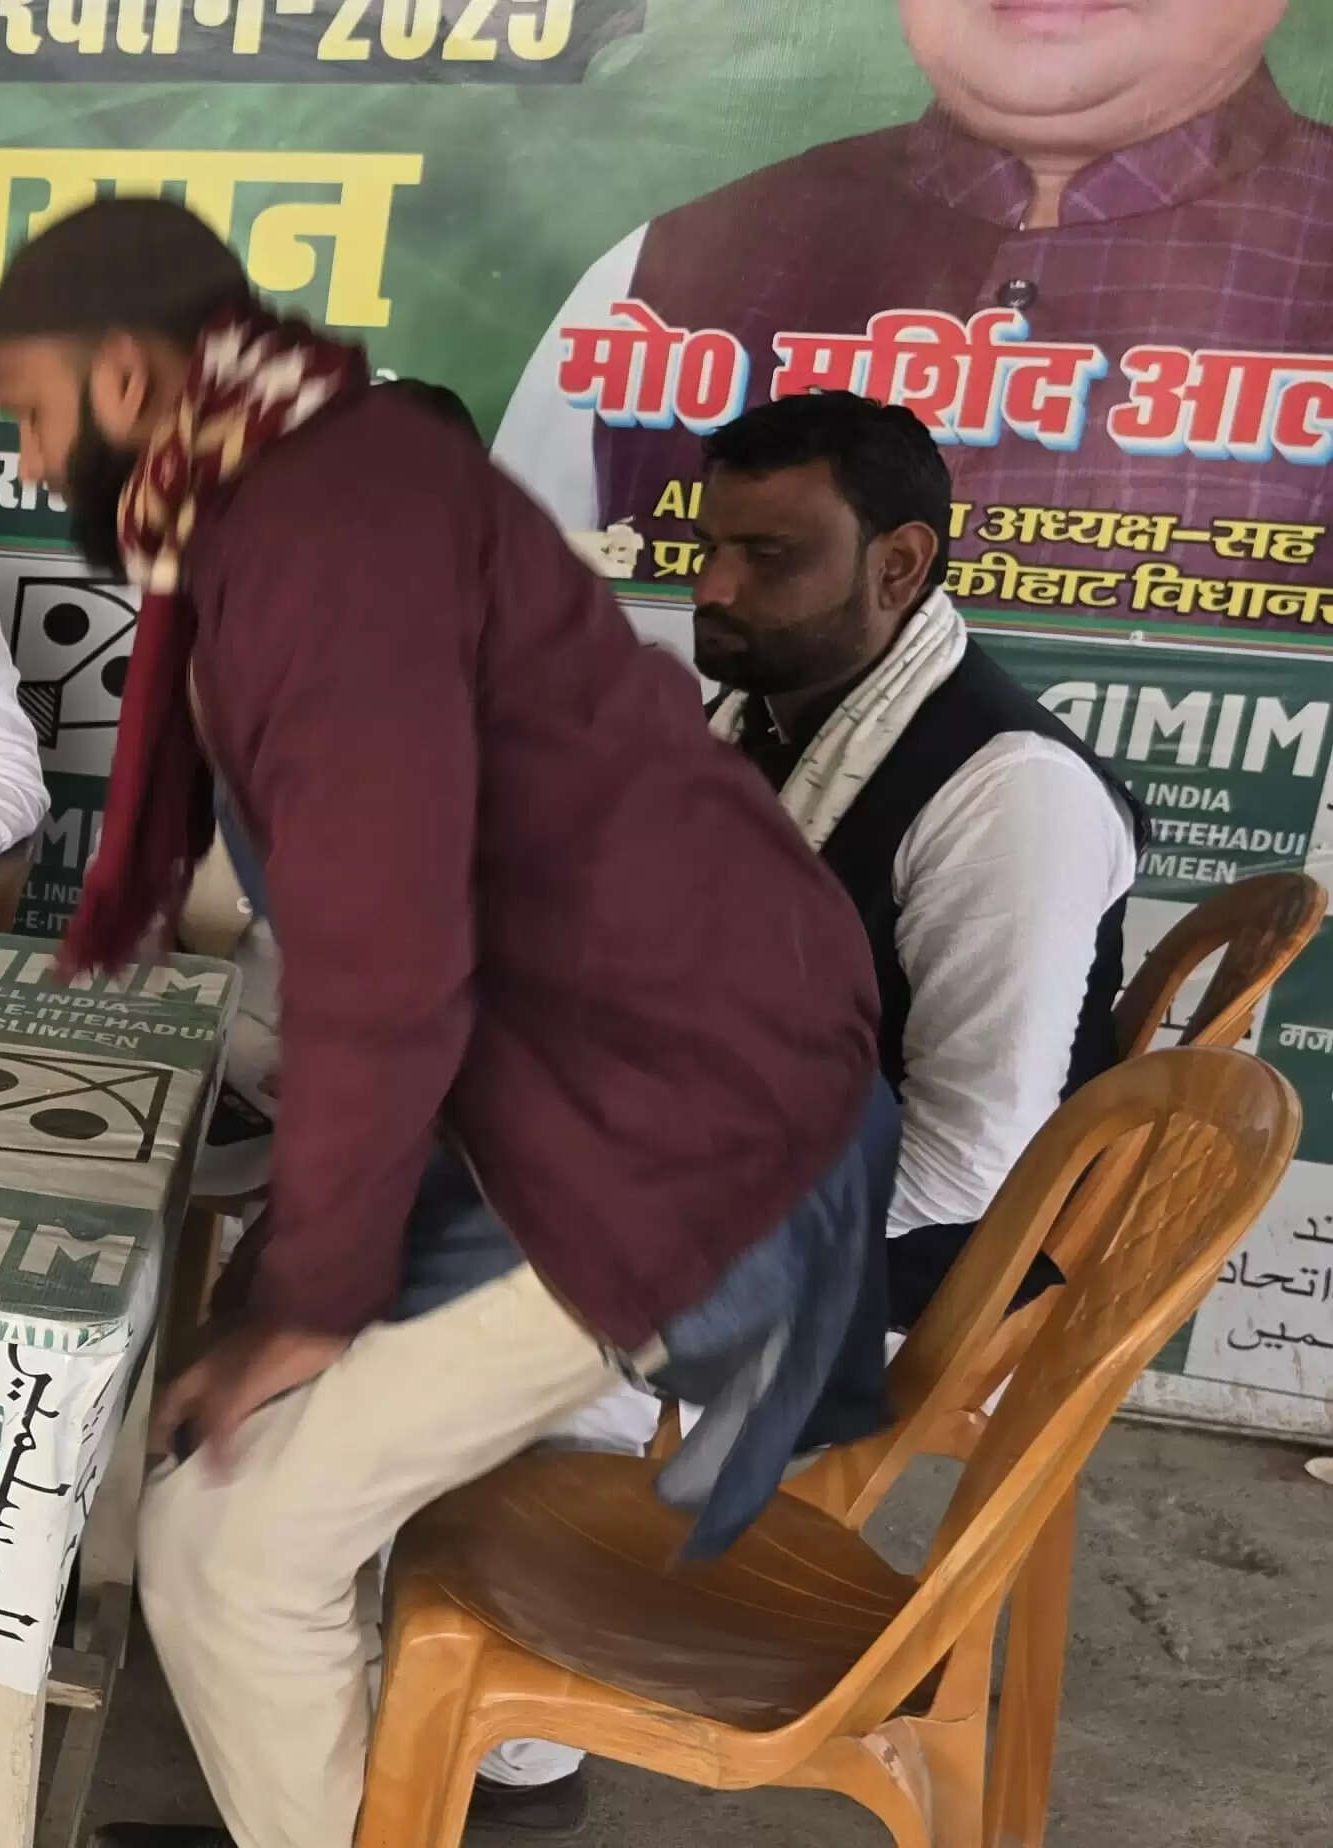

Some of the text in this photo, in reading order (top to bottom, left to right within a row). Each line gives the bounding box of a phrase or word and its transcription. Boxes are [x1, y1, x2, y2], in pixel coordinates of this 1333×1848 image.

[1109, 346, 1333, 459] आल
[1145, 782, 1231, 813] INDIA
[37, 992, 131, 1014] INDIA
